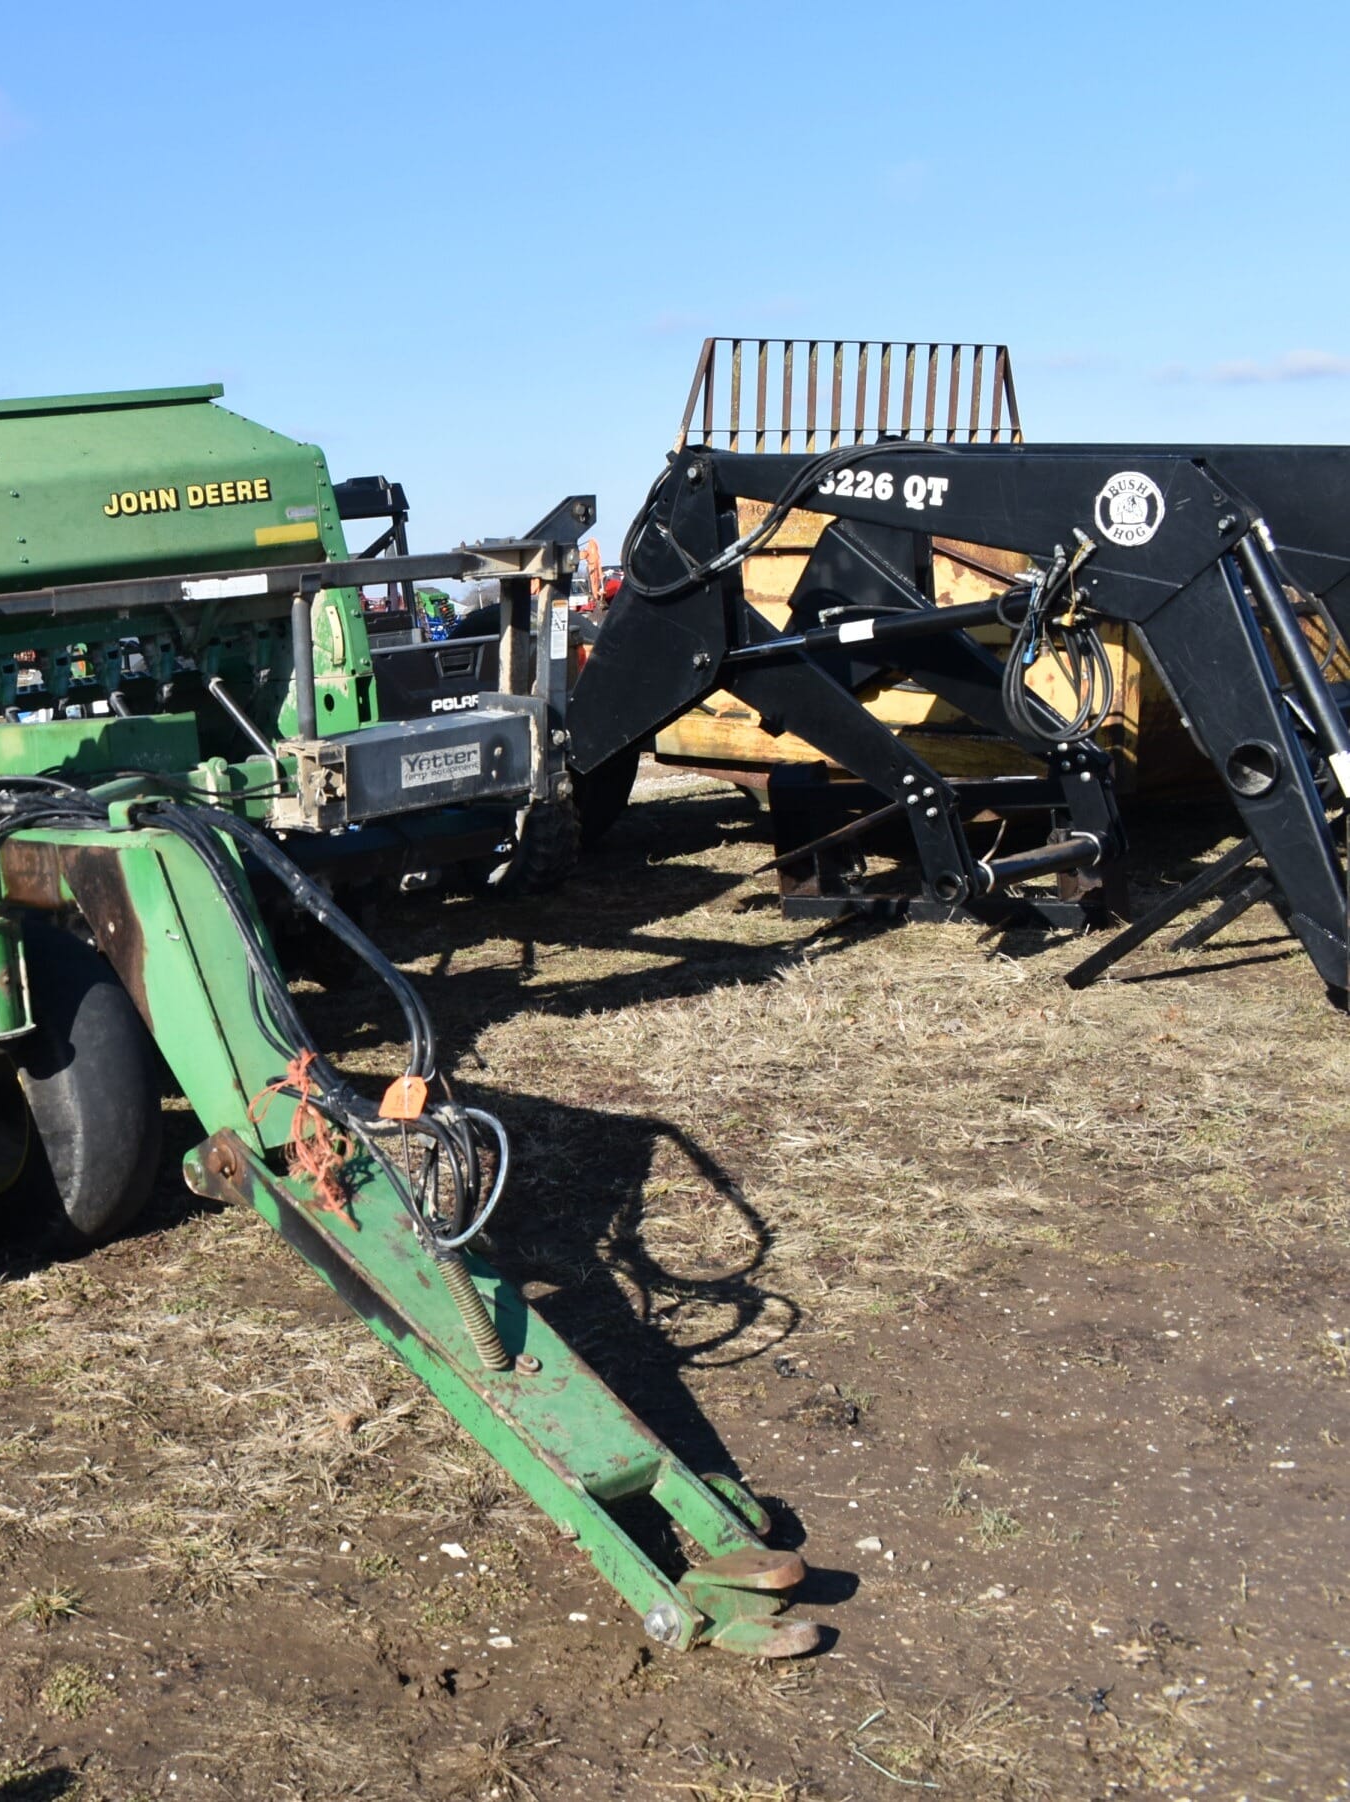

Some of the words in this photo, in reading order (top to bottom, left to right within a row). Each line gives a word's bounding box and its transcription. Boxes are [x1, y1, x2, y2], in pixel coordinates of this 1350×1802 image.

[103, 486, 179, 517] JOHN
[186, 478, 271, 509] DEERE
[903, 475, 949, 510] QT
[1108, 479, 1148, 497] BUSH
[1113, 526, 1146, 541] HOG
[403, 749, 479, 773] Yetter
